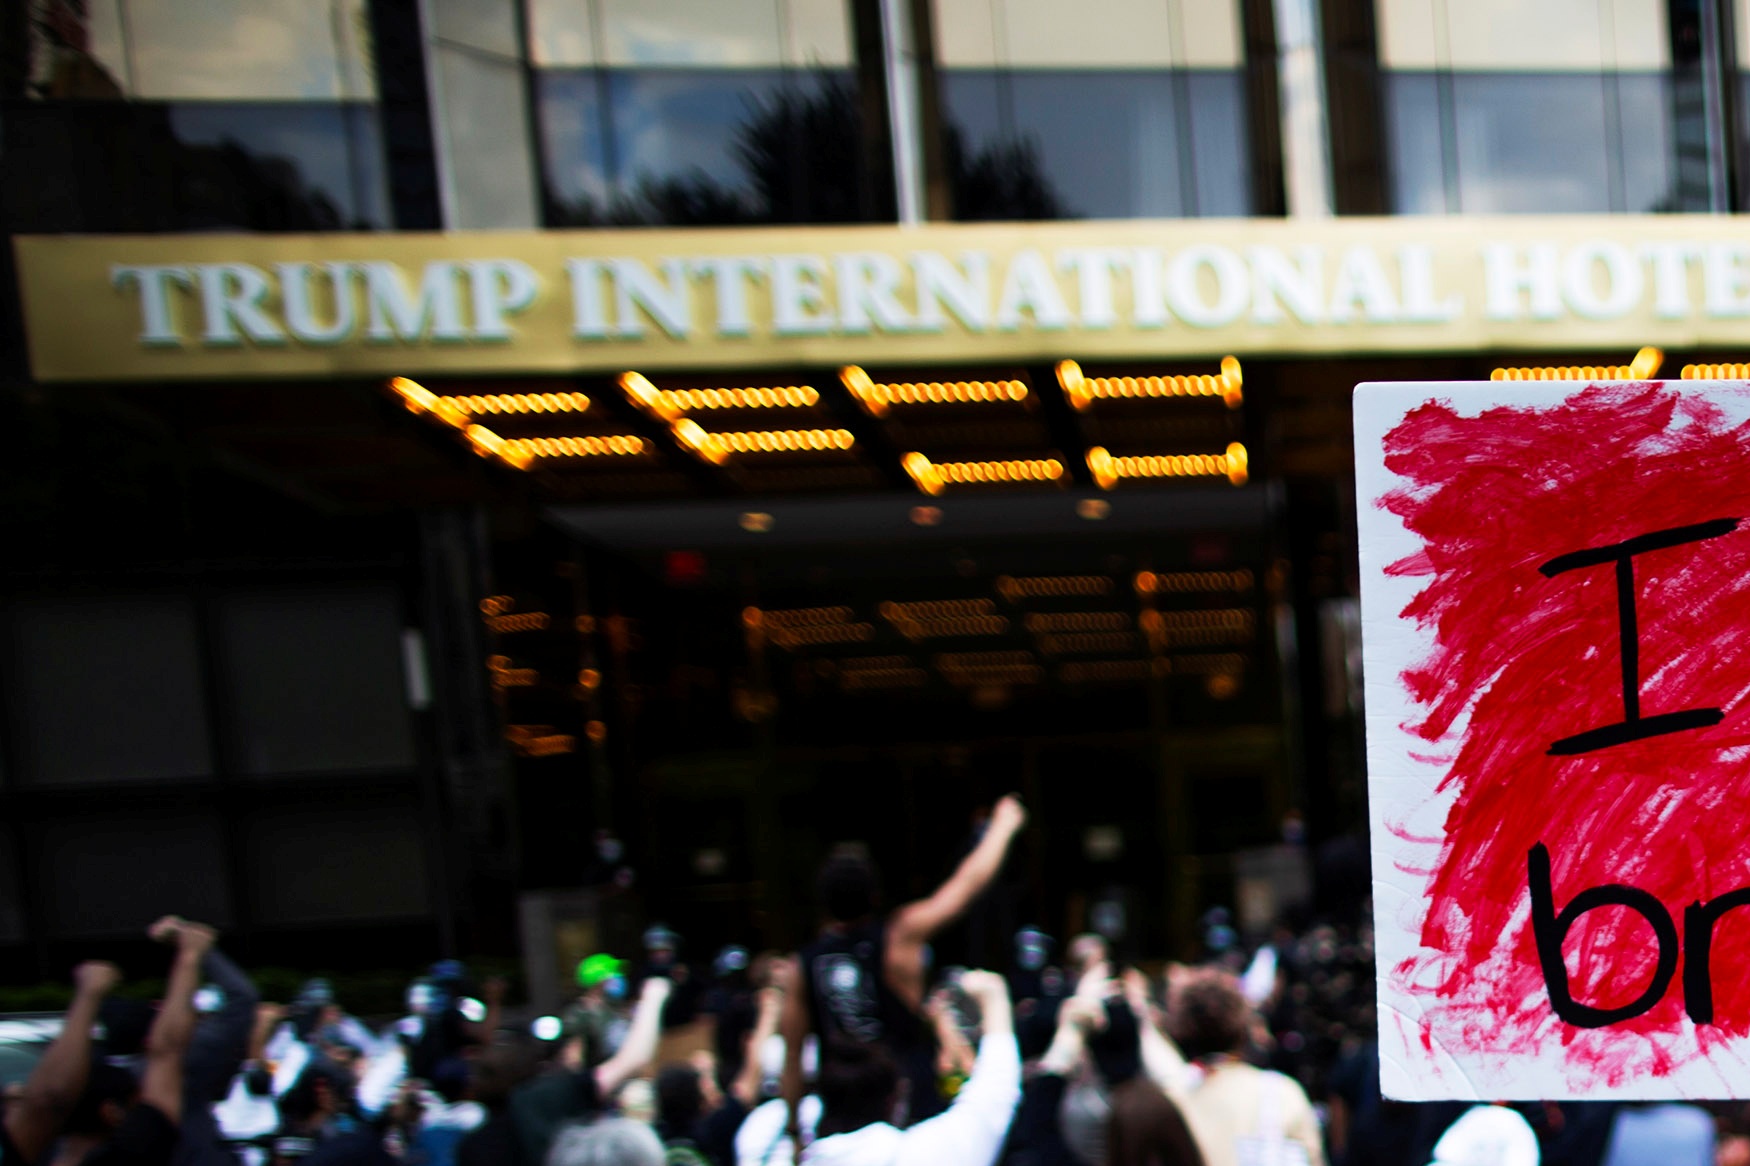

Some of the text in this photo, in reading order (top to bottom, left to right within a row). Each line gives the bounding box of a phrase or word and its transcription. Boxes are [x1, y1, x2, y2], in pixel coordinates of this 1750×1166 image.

[110, 258, 539, 348] TRUMP
[567, 242, 1463, 340] INTERNATIONAL
[1538, 517, 1741, 756] I
